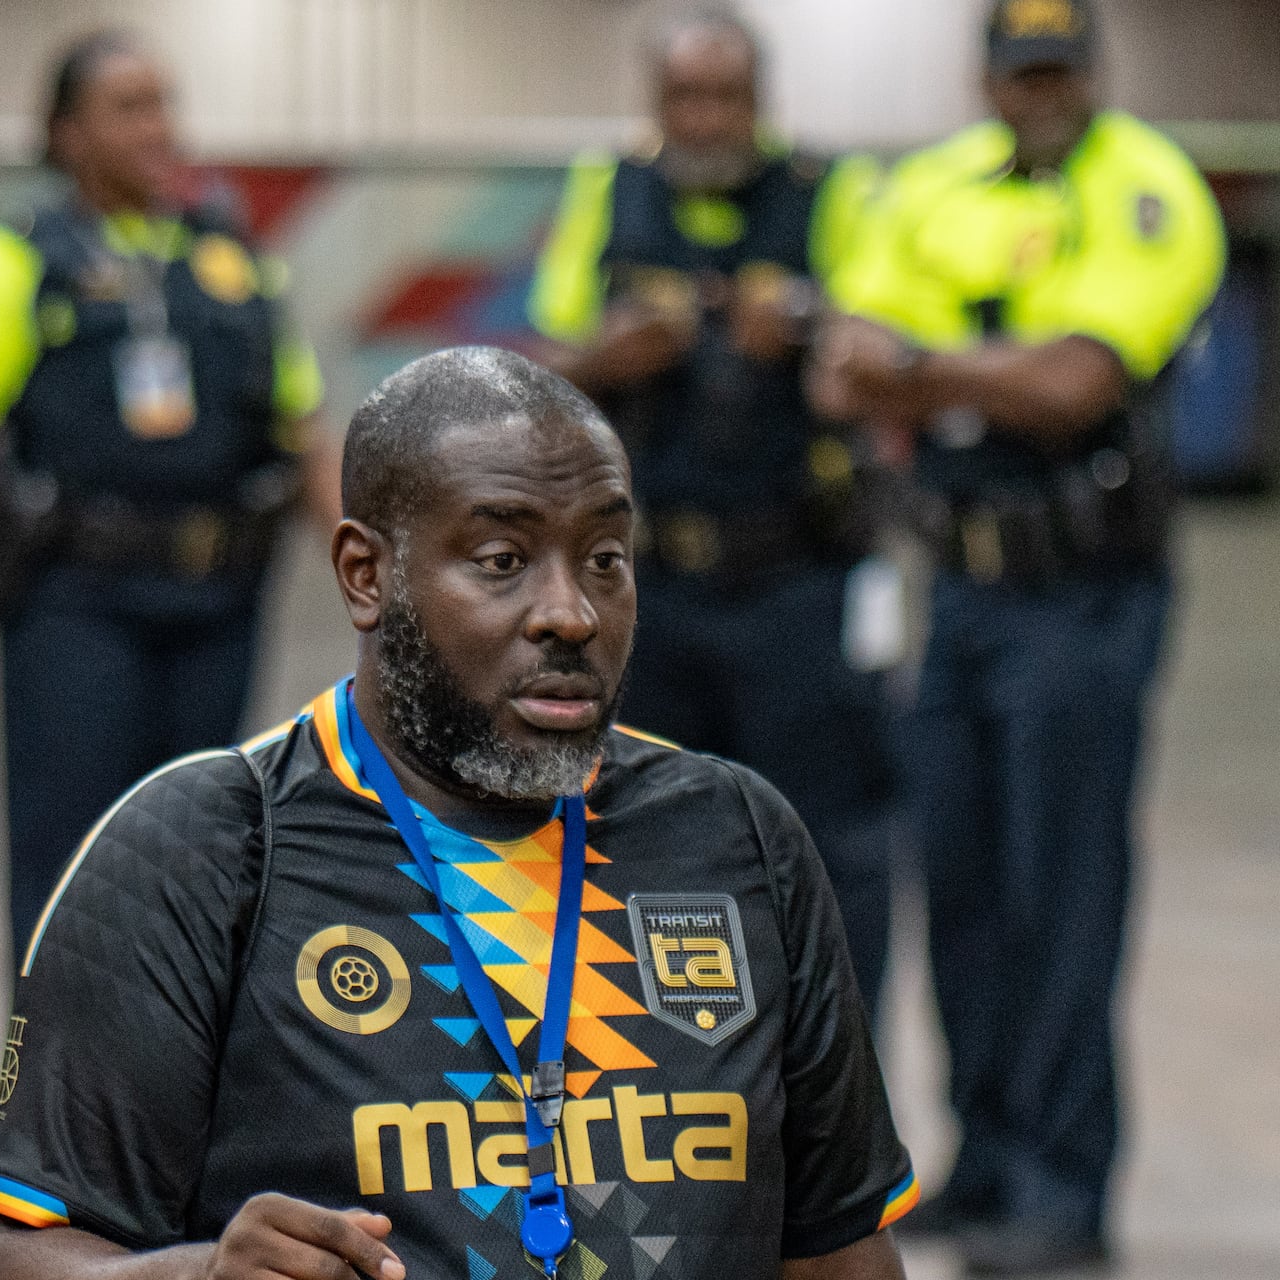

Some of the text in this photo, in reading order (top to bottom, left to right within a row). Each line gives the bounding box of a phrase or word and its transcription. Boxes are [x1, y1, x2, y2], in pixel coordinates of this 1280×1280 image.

[647, 914, 723, 928] TRANSIT
[649, 933, 736, 988] ta
[663, 994, 739, 1003] AMBASSADOR
[353, 1086, 748, 1195] marta
